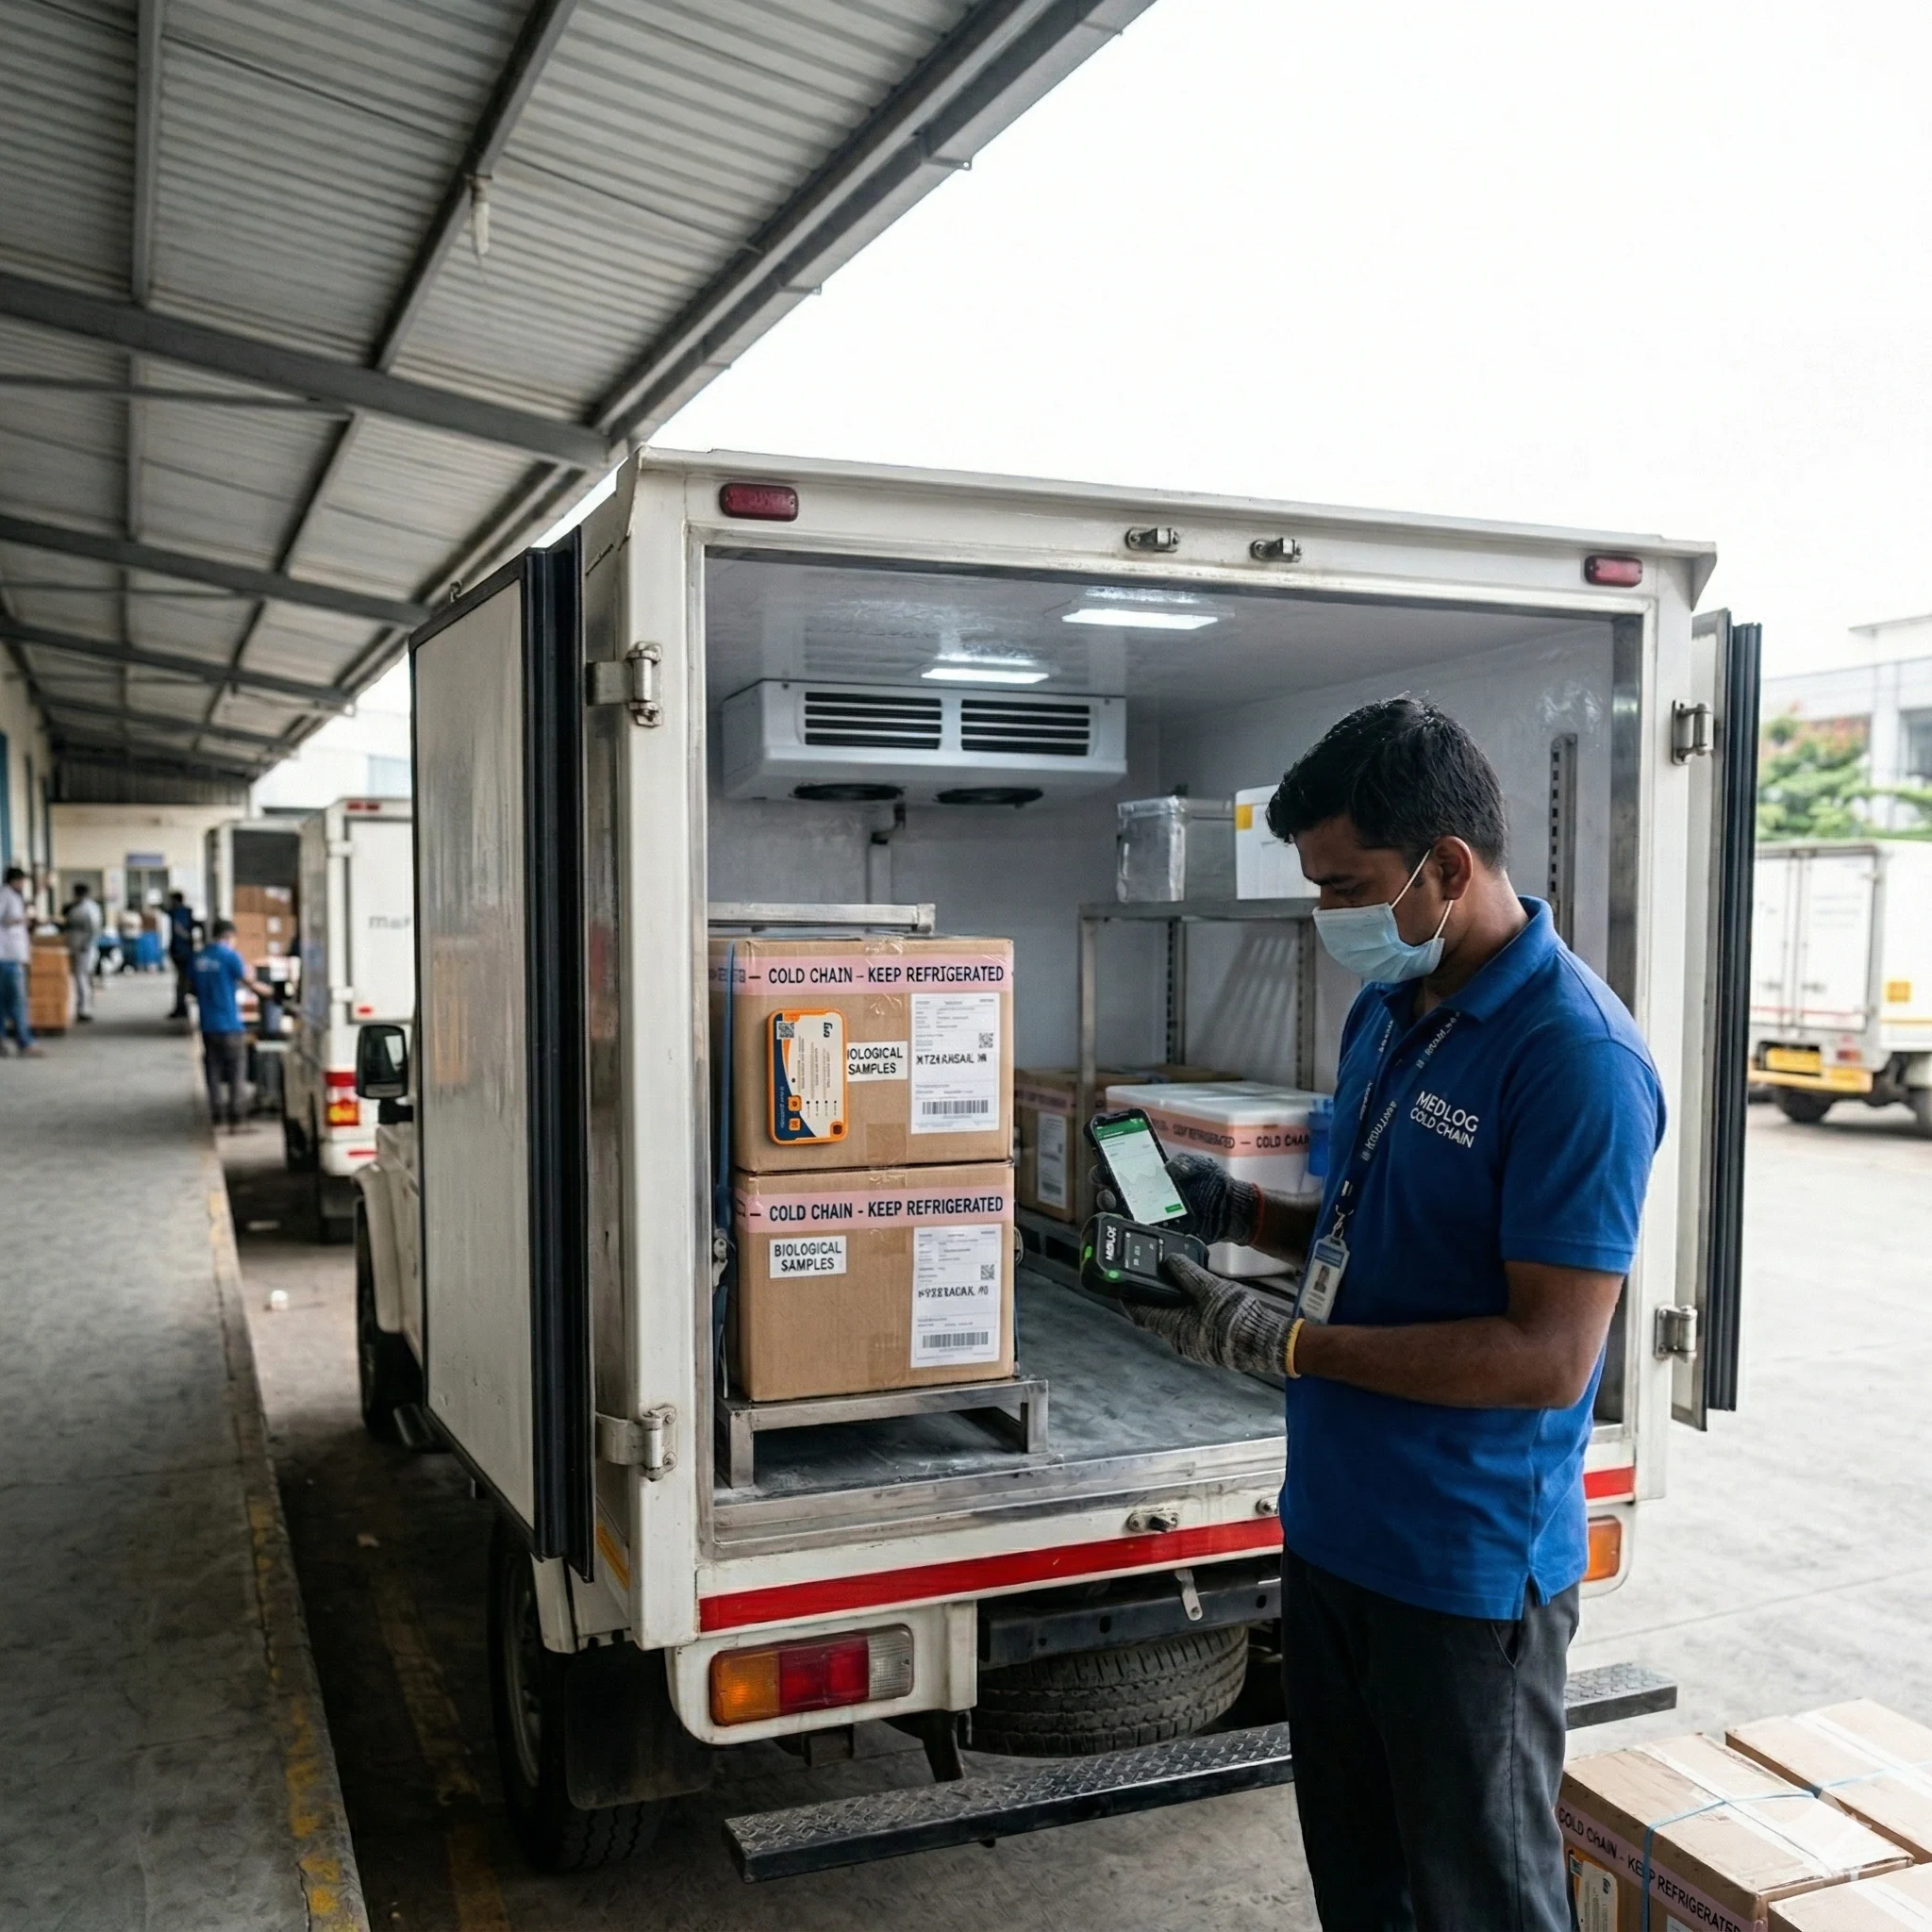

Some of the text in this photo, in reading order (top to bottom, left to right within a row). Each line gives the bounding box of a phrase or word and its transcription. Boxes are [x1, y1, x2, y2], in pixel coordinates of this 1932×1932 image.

[769, 968, 805, 983] COLD
[809, 967, 853, 983] CHAIN
[868, 967, 902, 982] KEEP
[907, 966, 1004, 982] REFRIGERATED
[847, 1047, 903, 1060] IOLOGICAL
[848, 1062, 896, 1075] SAMPLES
[1416, 1091, 1479, 1132] MEDLOG
[1410, 1108, 1474, 1148] COLD CHAIN
[1256, 1135, 1281, 1148] COLD
[770, 1205, 806, 1222] COLD
[811, 1203, 853, 1220] CHAIN
[868, 1201, 902, 1217] KEEP
[907, 1196, 1003, 1215] REFRIGERATED
[774, 1241, 841, 1257] BIOLOGICAL
[781, 1257, 834, 1272] SAMPLES
[1558, 1807, 1584, 1836] COLD
[1587, 1827, 1617, 1859] CHAIN
[1627, 1854, 1656, 1883] KEP
